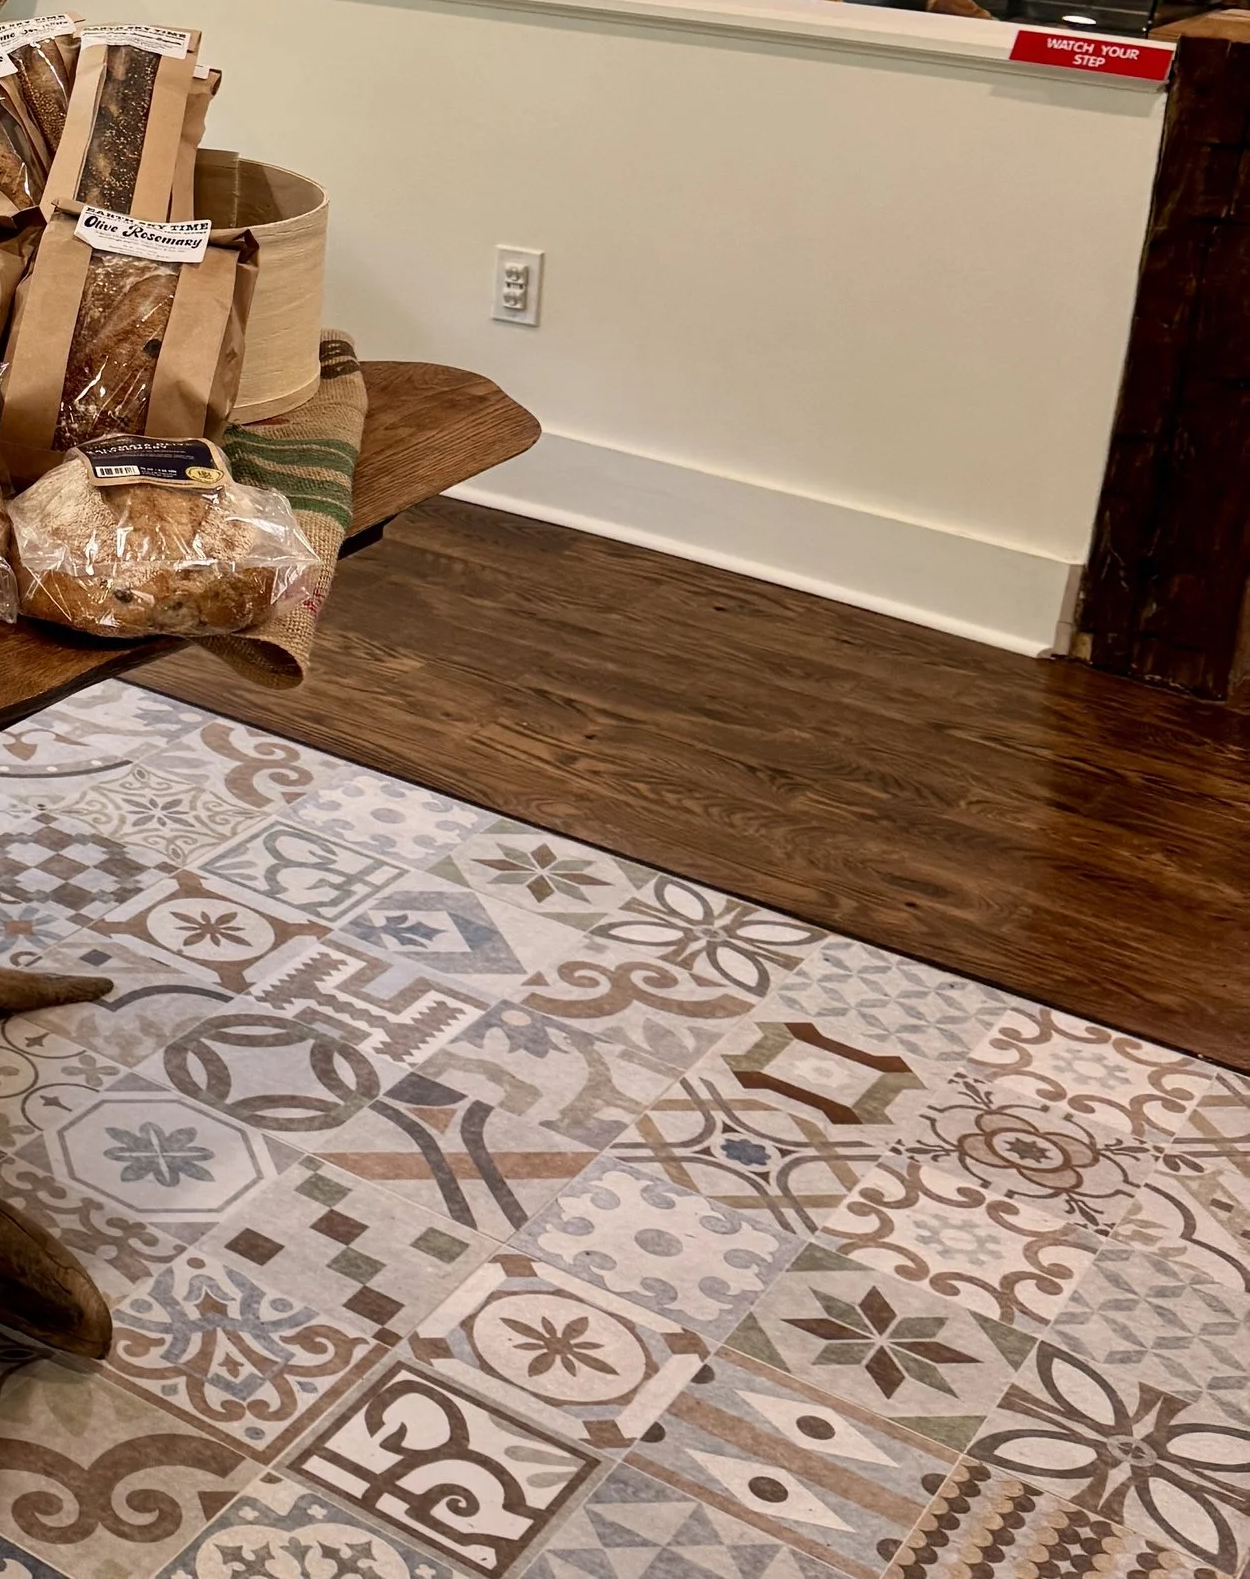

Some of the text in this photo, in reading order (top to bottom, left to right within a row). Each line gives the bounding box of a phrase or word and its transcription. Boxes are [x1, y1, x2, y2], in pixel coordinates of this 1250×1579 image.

[1046, 37, 1140, 61] WATCH YOUR
[1072, 54, 1106, 68] STEP
[84, 215, 119, 232] Olive
[122, 224, 203, 249] Rosemary
[170, 222, 209, 231] TIME
